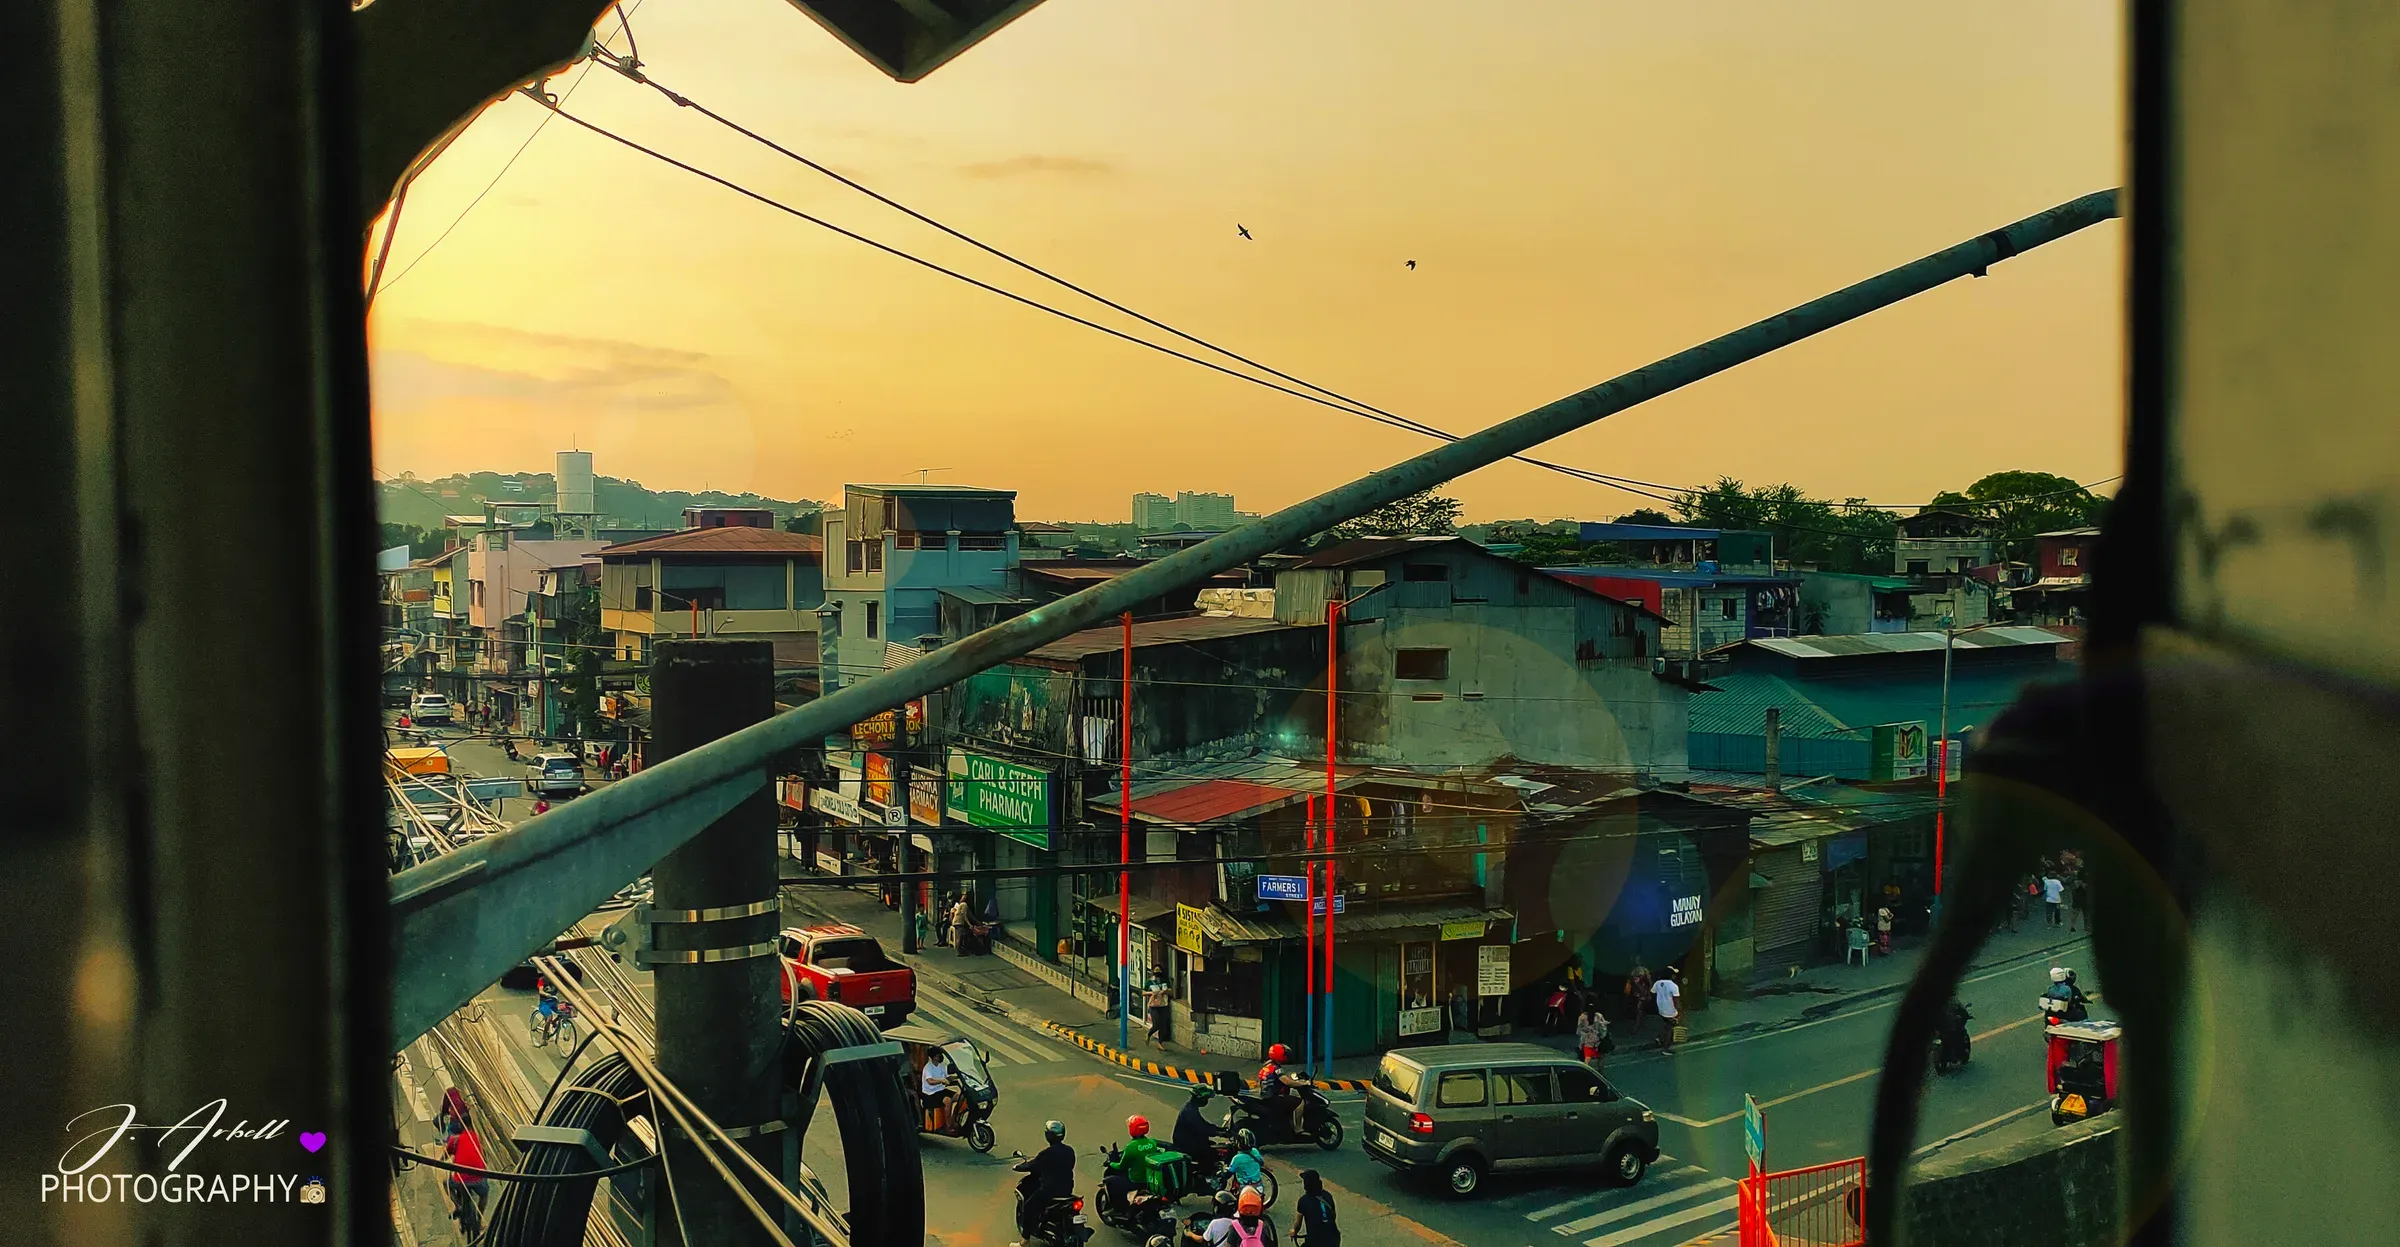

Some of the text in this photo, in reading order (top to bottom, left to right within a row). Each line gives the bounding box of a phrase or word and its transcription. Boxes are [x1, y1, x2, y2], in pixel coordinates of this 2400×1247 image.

[854, 721, 888, 735] LECHON
[972, 760, 1042, 801] CARL & STEPH
[979, 788, 1034, 825] PHARMACY
[1262, 881, 1297, 893] FARMERS
[1670, 908, 1703, 927] GULAYAN
[1137, 1143, 1154, 1152] Grab
